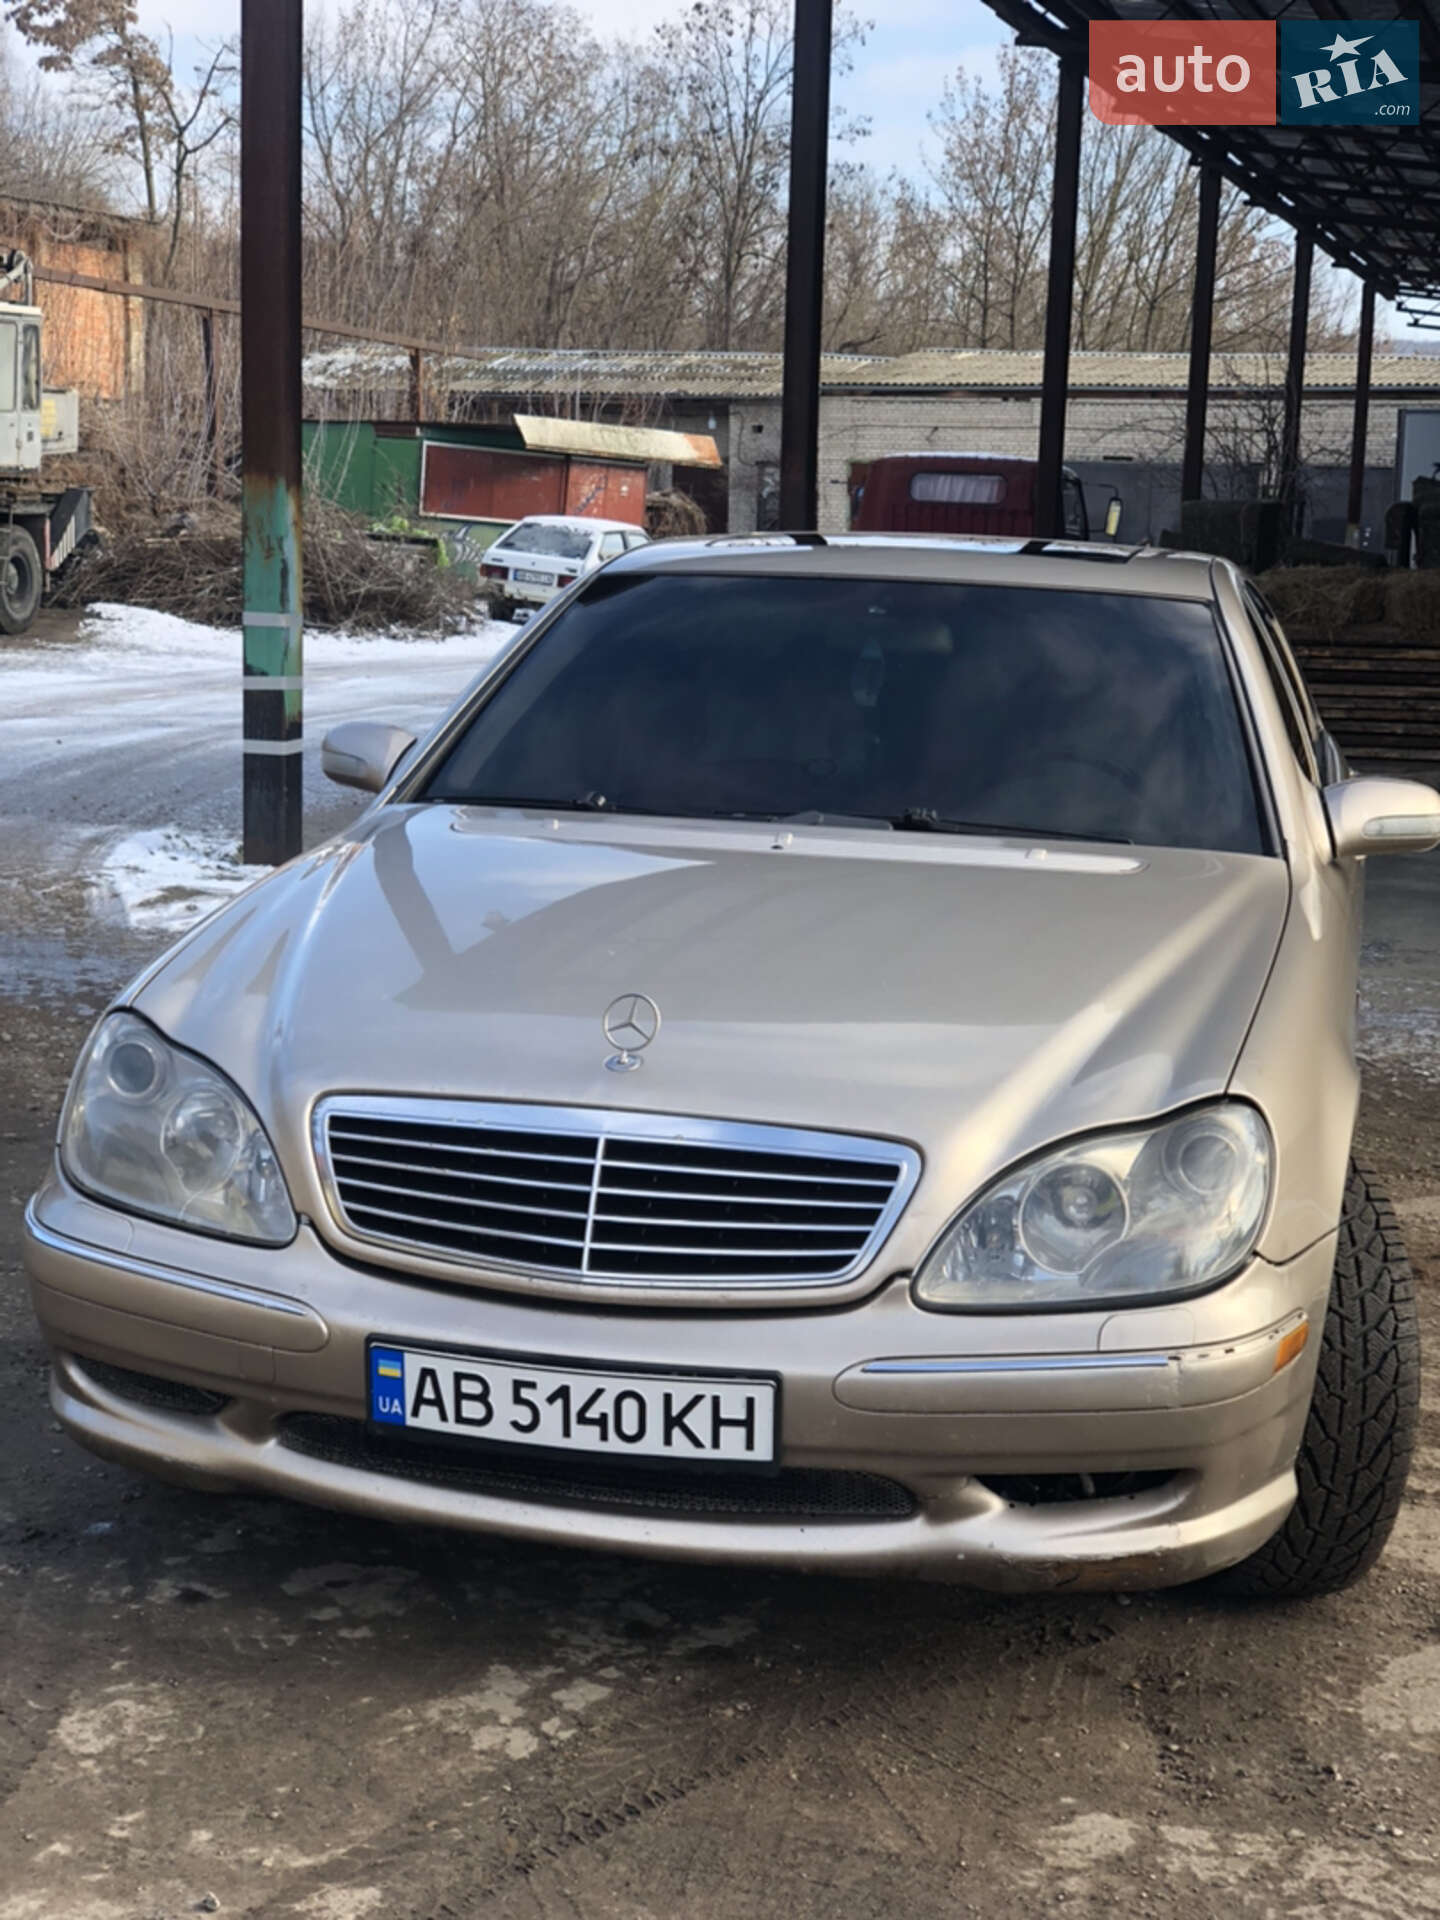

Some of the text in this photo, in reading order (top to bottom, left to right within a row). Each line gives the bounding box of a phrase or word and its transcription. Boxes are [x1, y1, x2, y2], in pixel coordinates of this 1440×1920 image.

[378, 1395, 403, 1416] UA
[410, 1366, 756, 1452] AB 5140 KH
